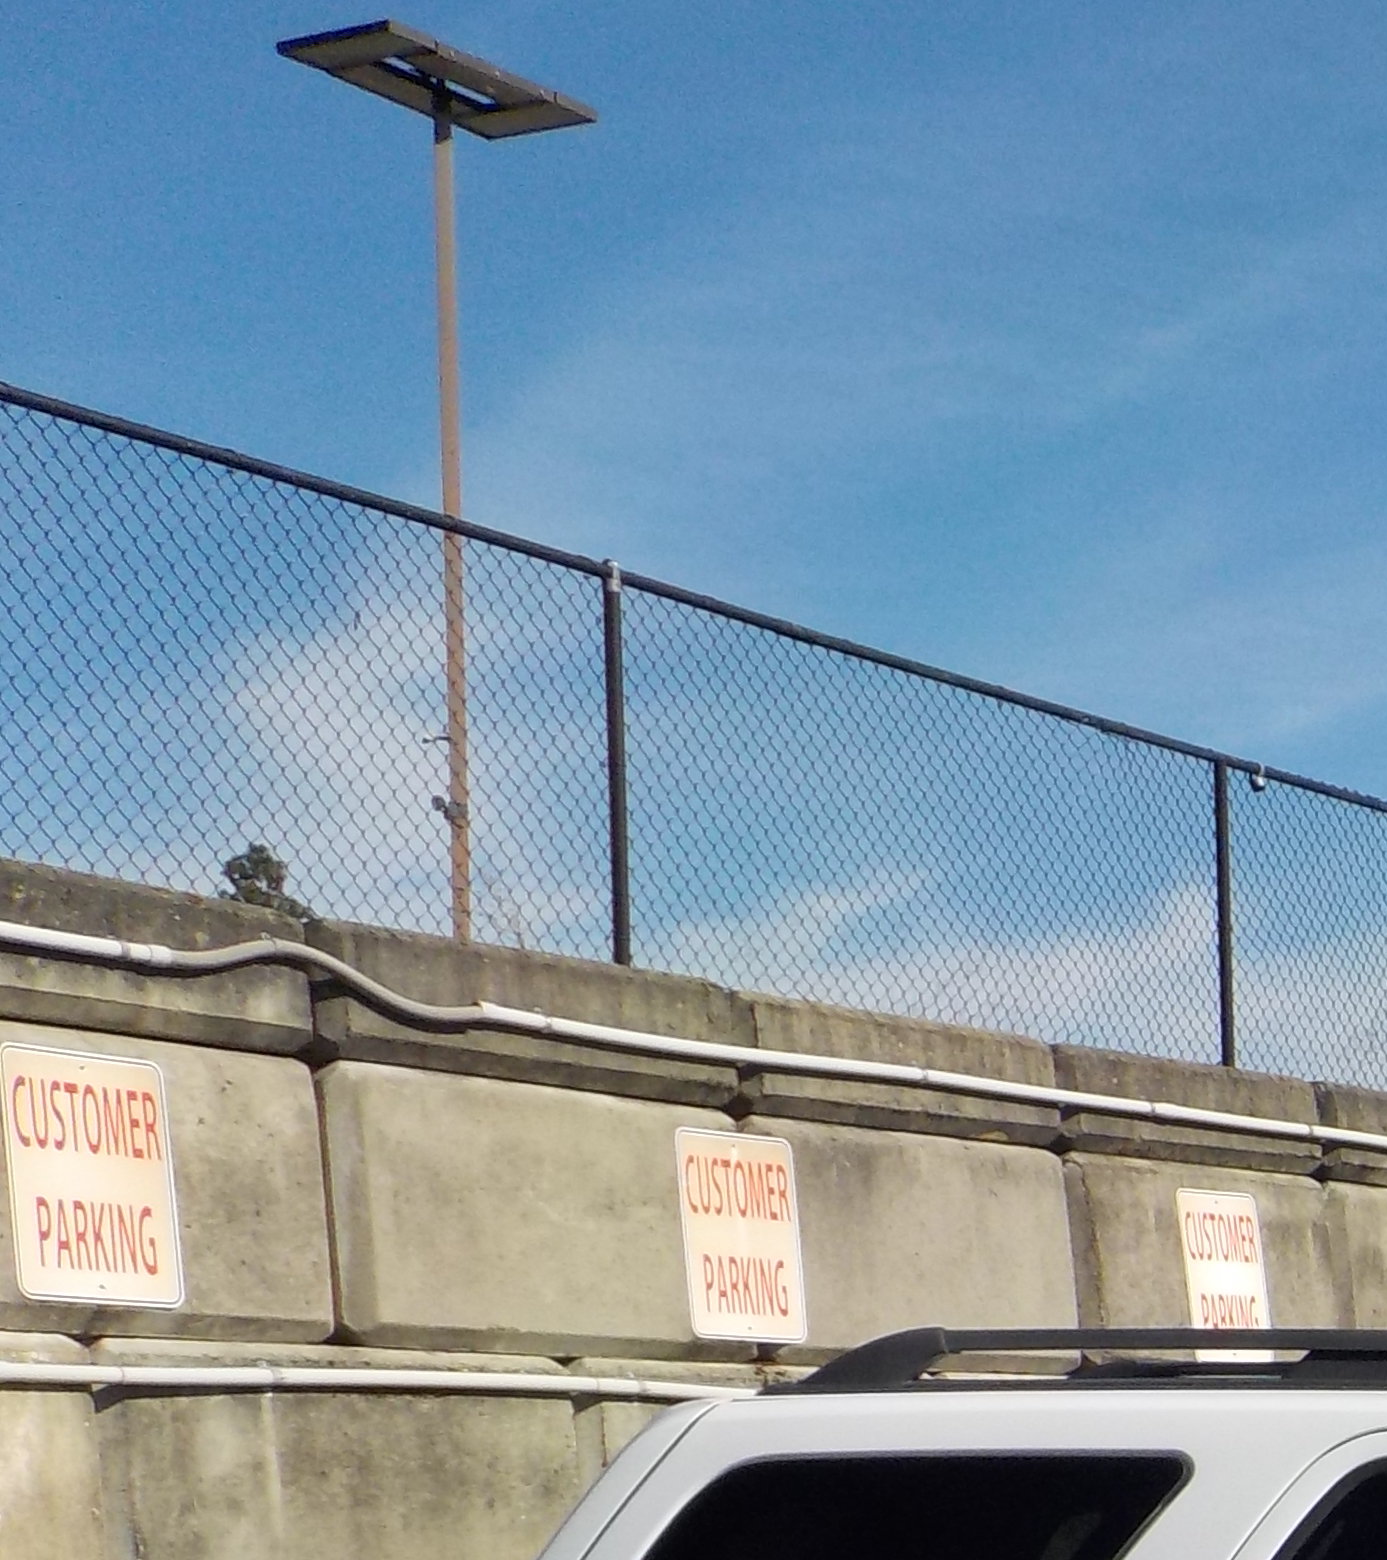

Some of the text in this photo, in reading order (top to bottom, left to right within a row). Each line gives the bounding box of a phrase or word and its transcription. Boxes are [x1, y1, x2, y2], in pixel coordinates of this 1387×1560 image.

[12, 1075, 162, 1161] CUSTOMER
[685, 1154, 792, 1223] CUSTOMER
[35, 1196, 159, 1276] PARKING
[1184, 1211, 1259, 1264] CUSTOMER
[702, 1254, 789, 1317] PARKING
[1201, 1293, 1260, 1330] PARKING
